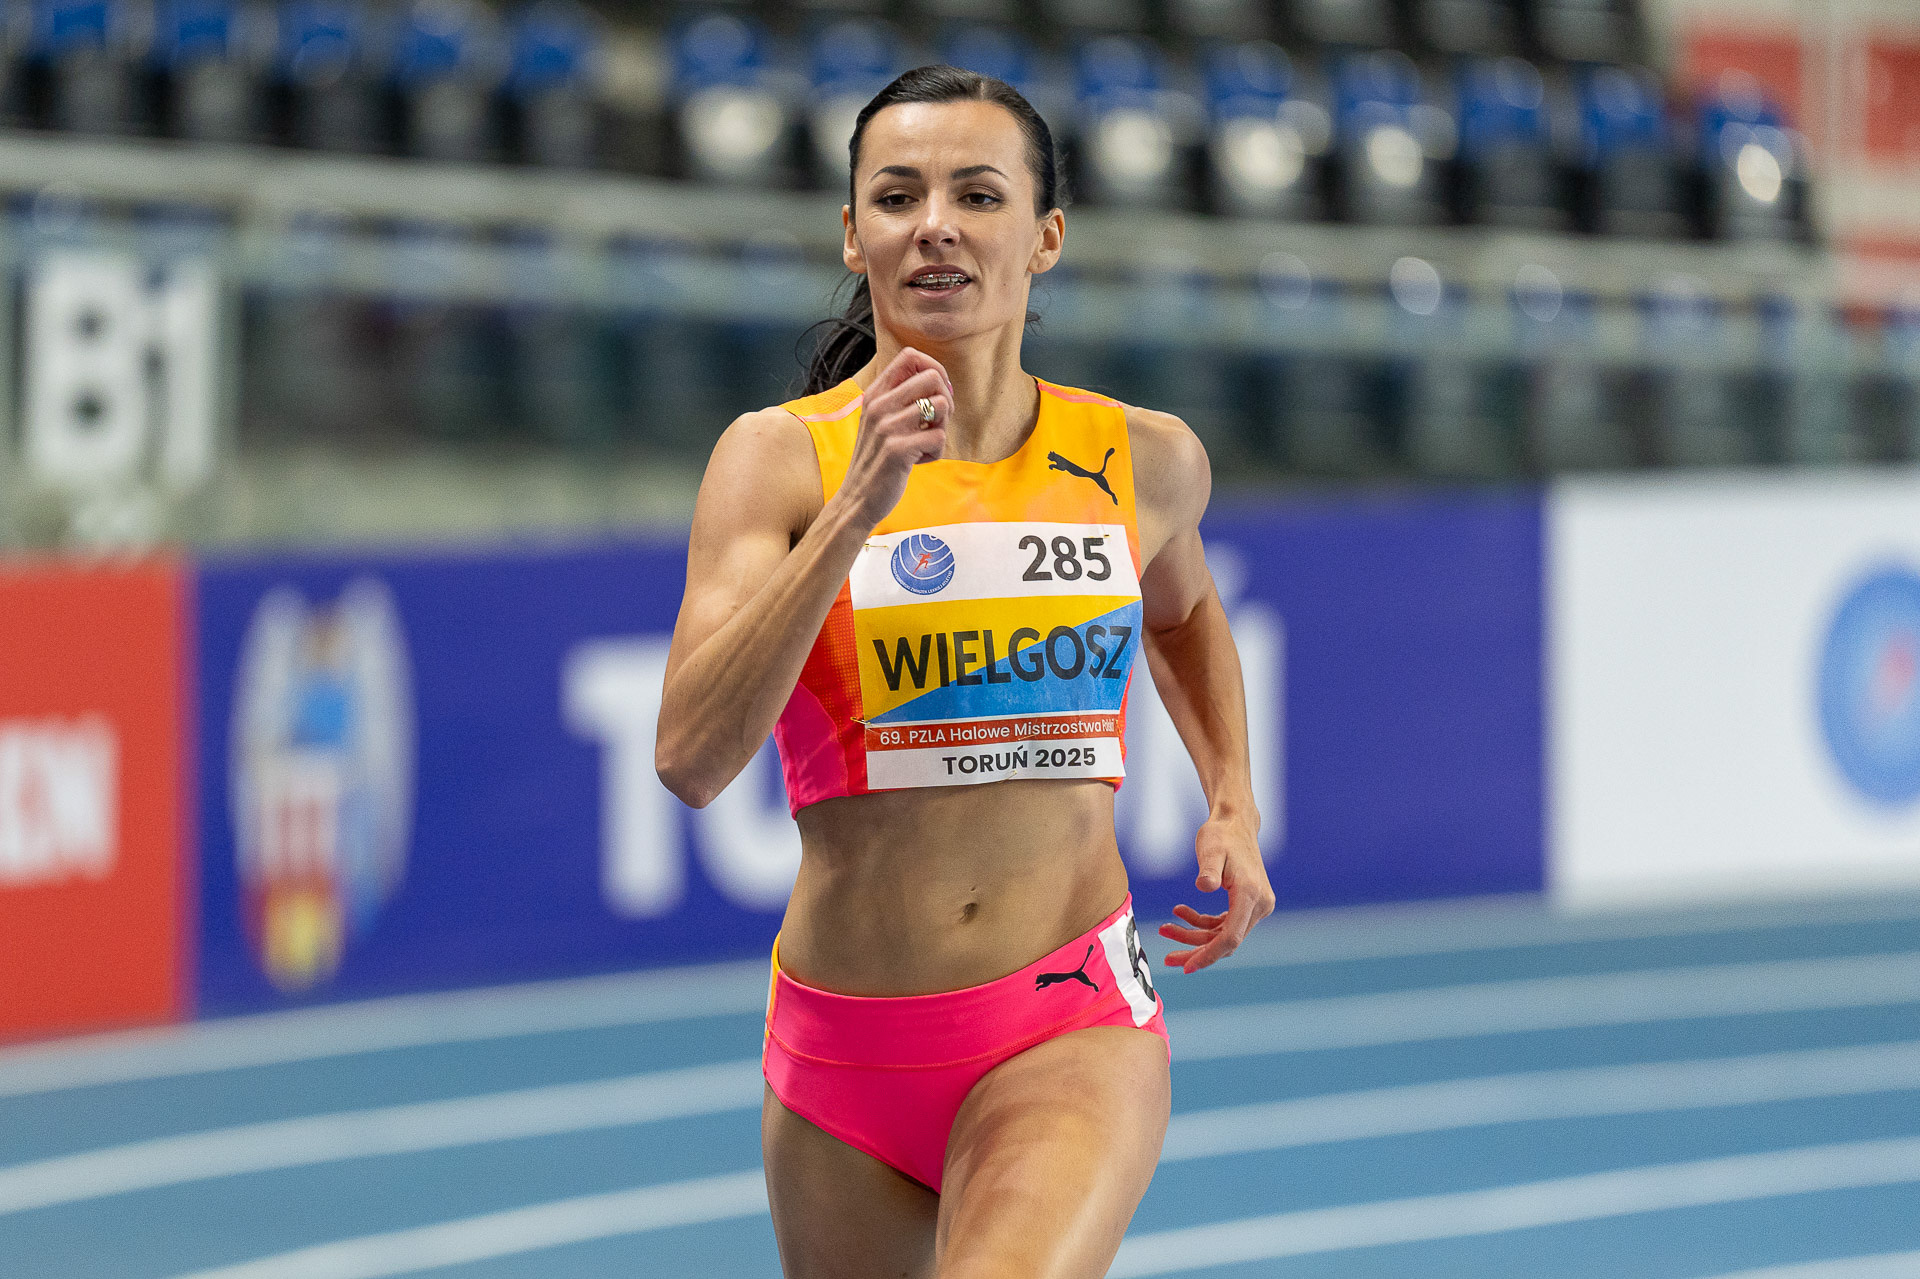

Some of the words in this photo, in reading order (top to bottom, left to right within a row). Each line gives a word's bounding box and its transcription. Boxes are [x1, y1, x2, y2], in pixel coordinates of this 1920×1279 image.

[1018, 535, 1112, 582] 285
[872, 624, 1132, 692] WIELGOSZ
[880, 731, 905, 746] 69.
[909, 729, 946, 744] PZLA
[950, 726, 1010, 742] Halowe
[1014, 720, 1102, 736] Mistrzostwa
[942, 745, 1028, 775] TORUŃ
[1035, 747, 1096, 768] 2025
